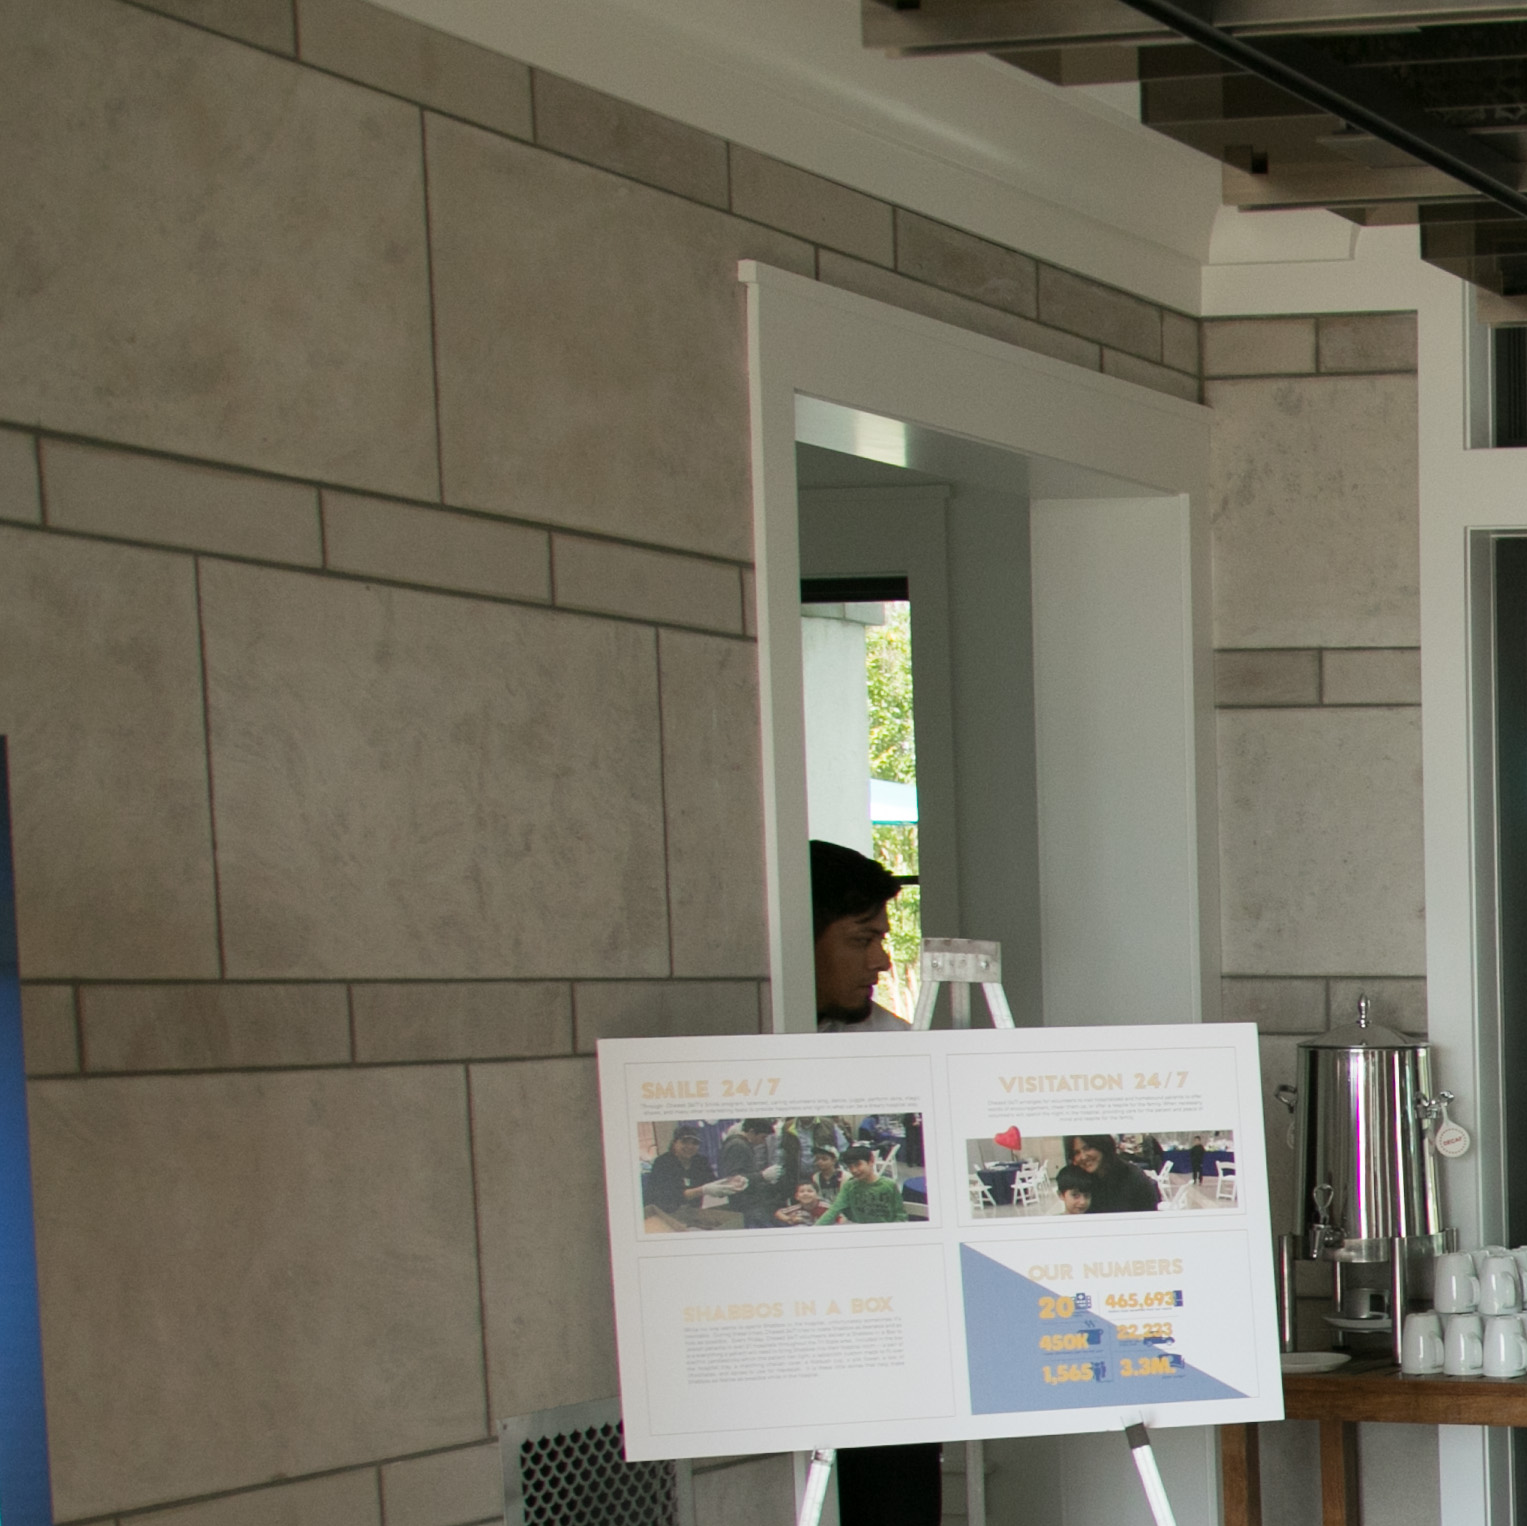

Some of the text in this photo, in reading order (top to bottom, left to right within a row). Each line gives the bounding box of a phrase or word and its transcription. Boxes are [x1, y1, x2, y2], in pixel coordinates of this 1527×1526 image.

[641, 1077, 781, 1100] SMILE 24/7
[998, 1071, 1189, 1094] VISITATION 24/7
[1028, 1258, 1184, 1282] OUR NUMBERS
[794, 1300, 817, 1317] IN
[826, 1299, 841, 1315] A
[851, 1296, 894, 1314] BOX
[1038, 1296, 1075, 1319] 20
